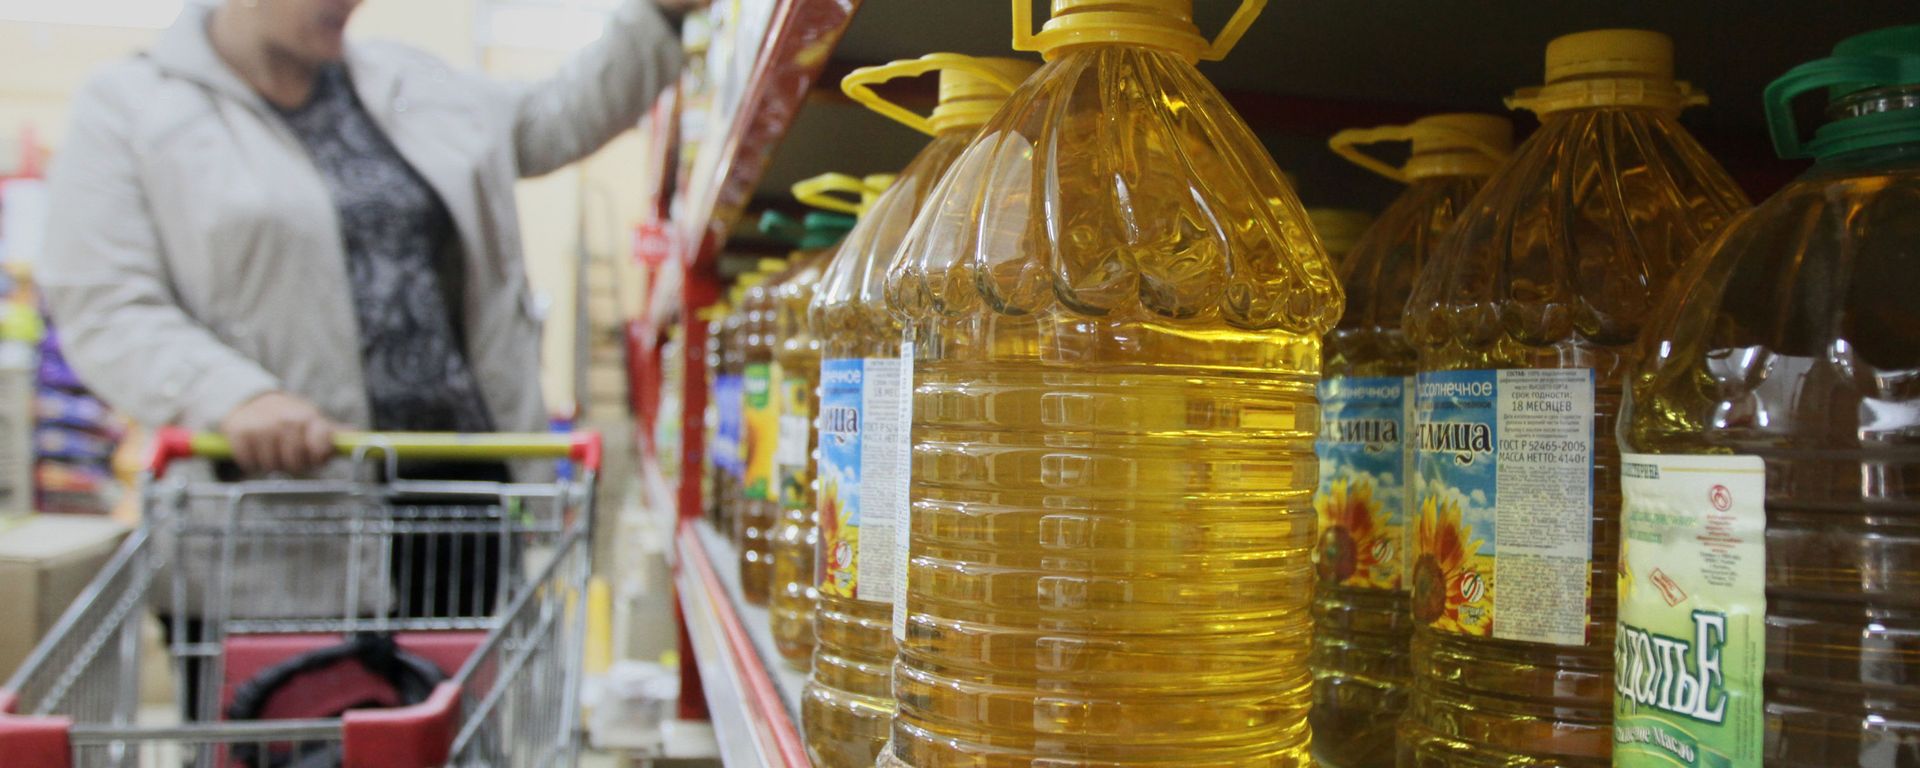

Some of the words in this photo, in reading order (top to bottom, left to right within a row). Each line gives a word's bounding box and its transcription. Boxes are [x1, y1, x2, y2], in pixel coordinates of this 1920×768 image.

[1512, 401, 1524, 412] 18
[1526, 400, 1572, 413] МЕСЯЦЕВ
[1499, 440, 1519, 451] ГОСТ
[1521, 440, 1527, 450] Р
[1529, 441, 1586, 452] 52465-2005
[1499, 452, 1525, 462] МАССА
[1527, 453, 1557, 463] НЕТТО:
